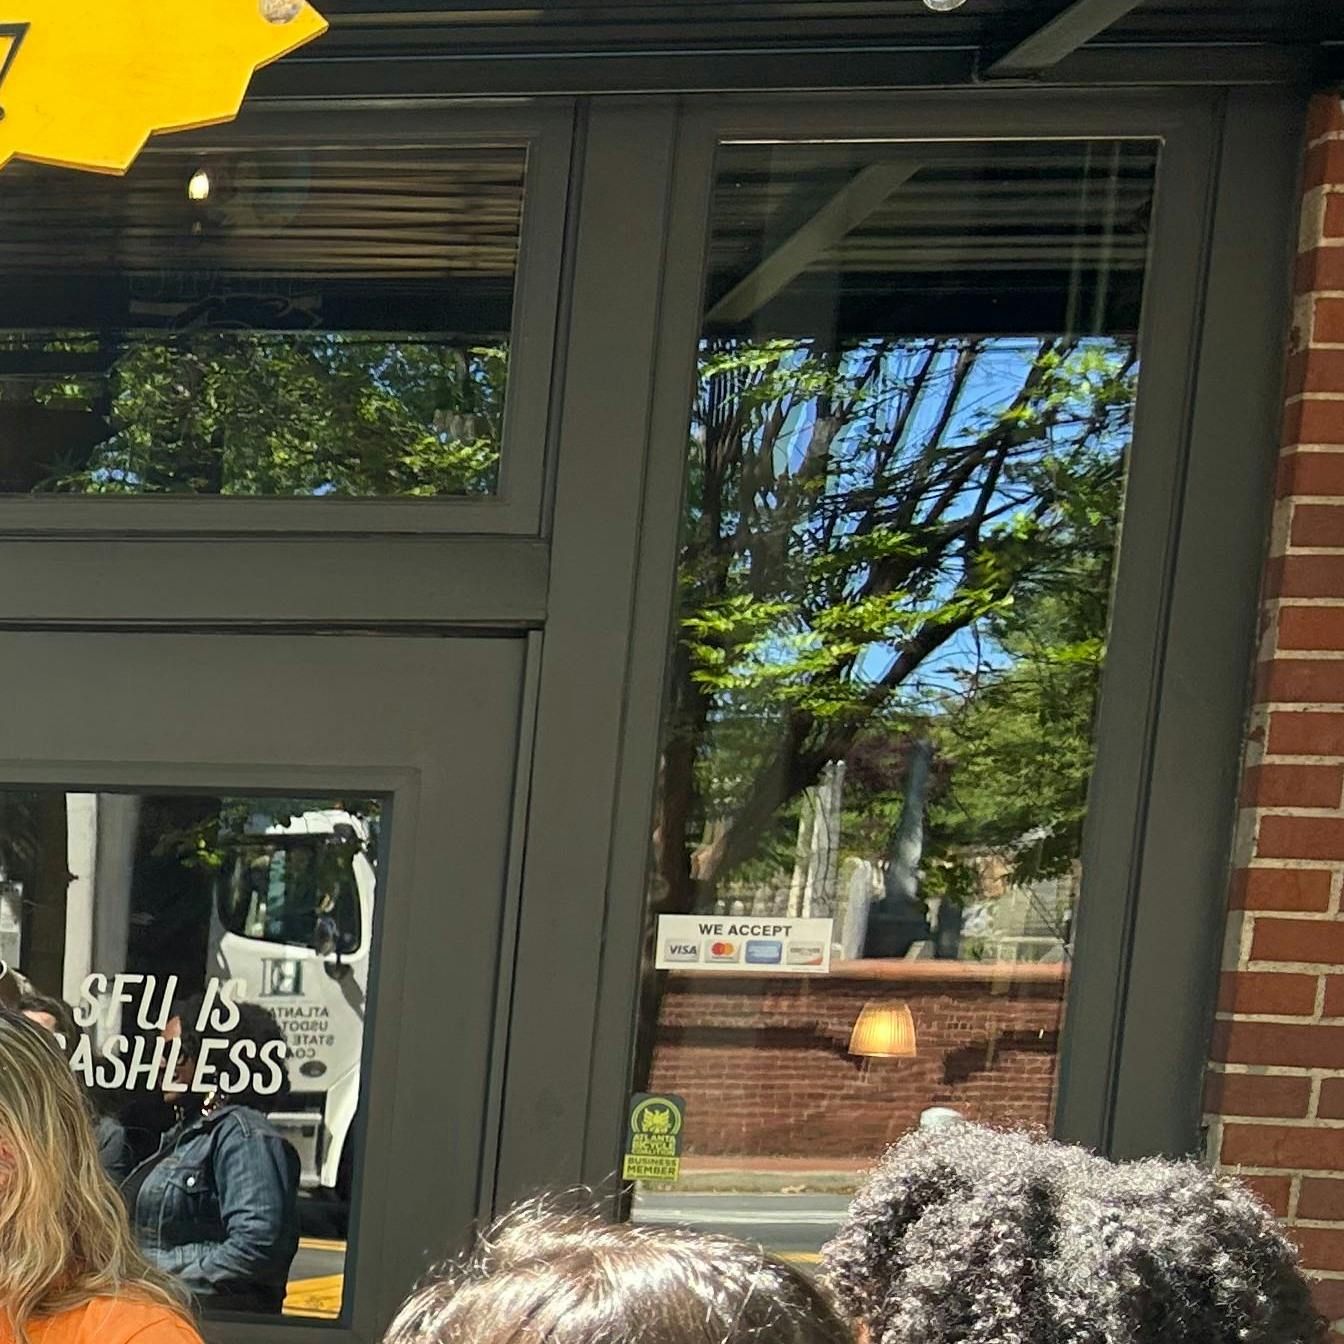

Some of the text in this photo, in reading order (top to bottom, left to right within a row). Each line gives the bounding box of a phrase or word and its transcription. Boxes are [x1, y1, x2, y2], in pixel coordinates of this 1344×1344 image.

[699, 923, 792, 938] WE ACCEPT
[670, 944, 697, 955] VISA
[73, 973, 178, 1031] SFU
[195, 977, 247, 1032] IS
[54, 1033, 288, 1095] ASHLESS
[626, 1166, 675, 1175] MEMBER
